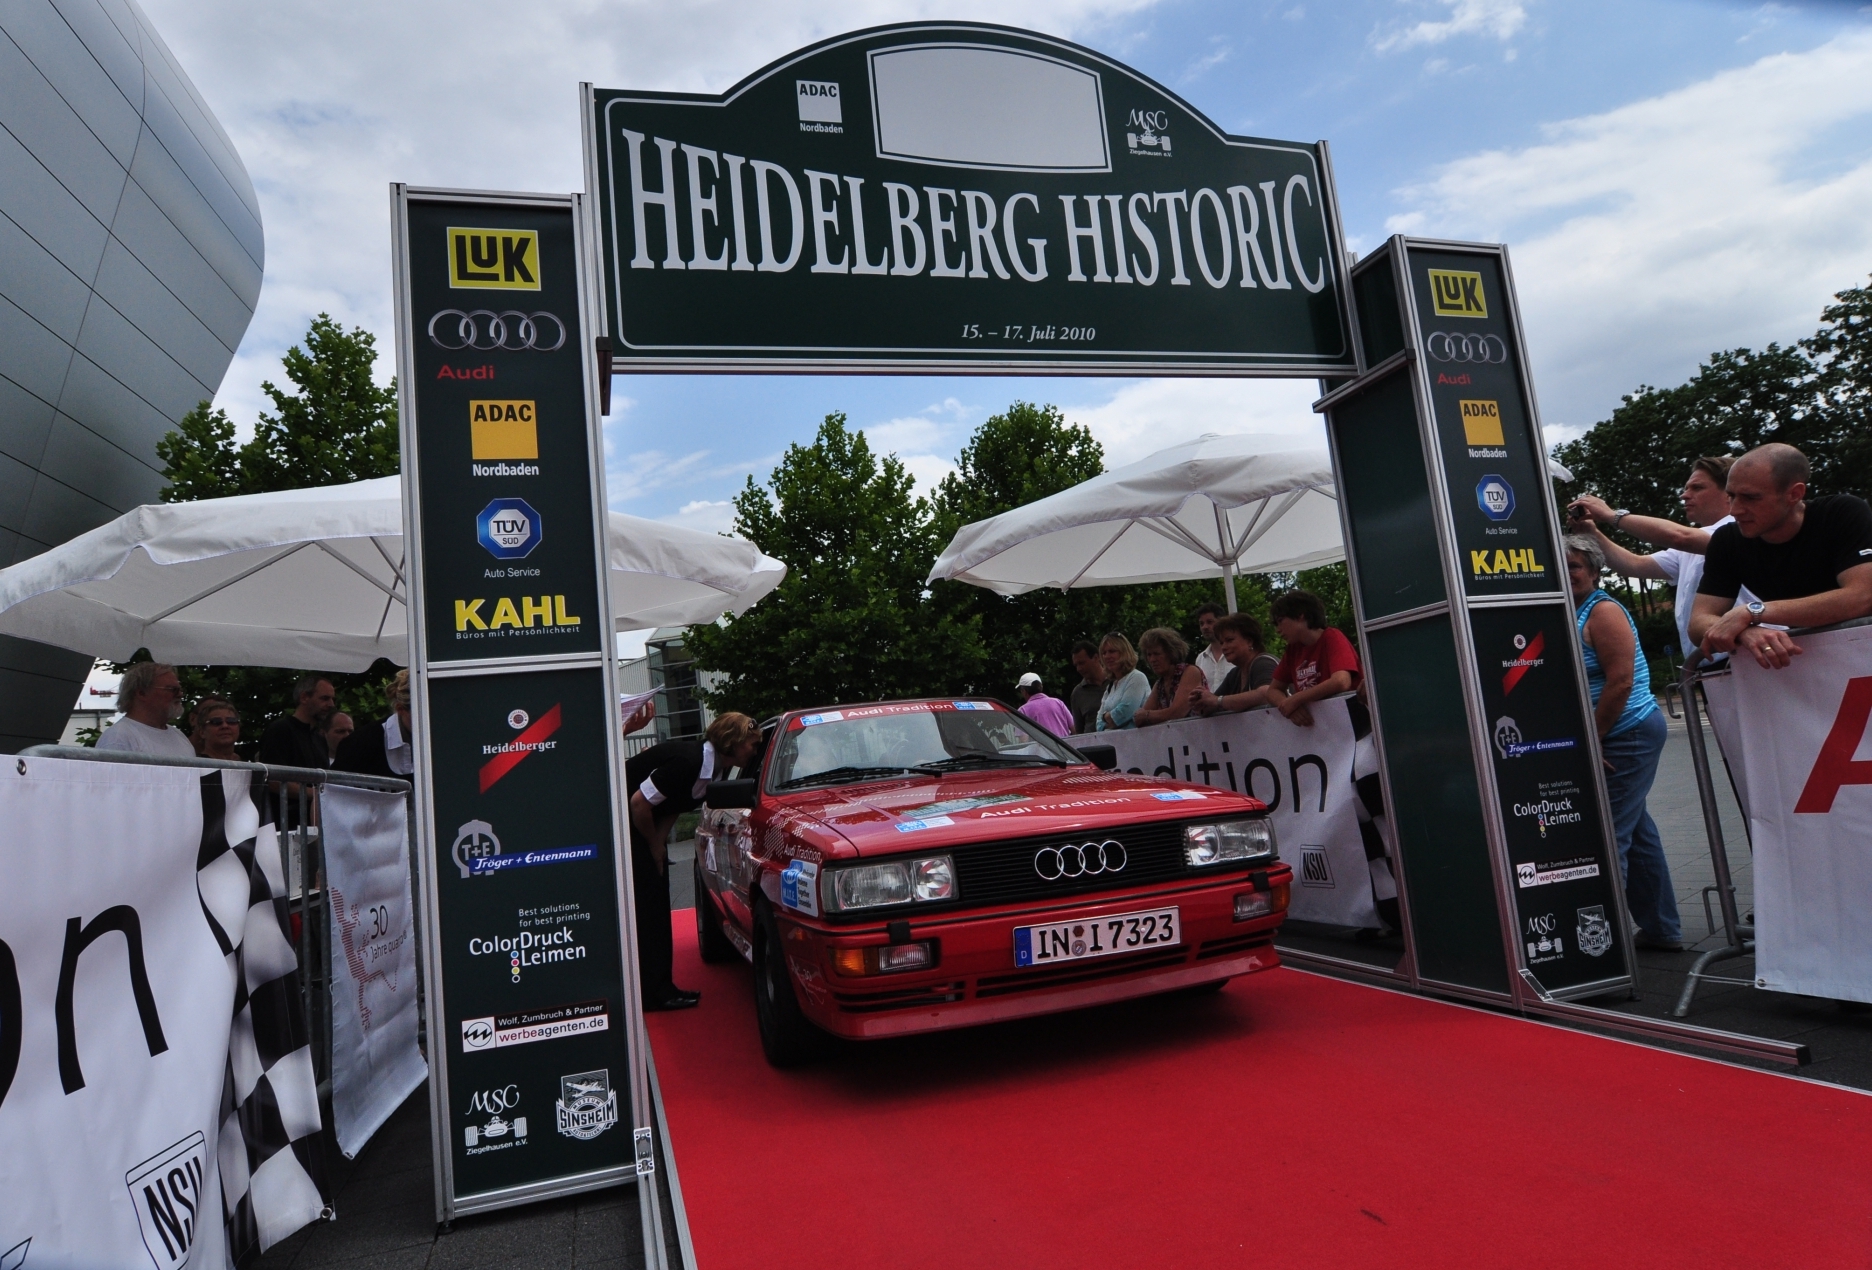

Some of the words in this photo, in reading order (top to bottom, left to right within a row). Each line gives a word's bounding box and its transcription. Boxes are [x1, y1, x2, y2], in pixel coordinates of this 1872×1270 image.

[800, 84, 838, 98] ADAC
[1126, 108, 1168, 131] MSC
[800, 122, 843, 134] Nordbaden
[1129, 148, 1162, 158] Ziegelhausen
[622, 128, 1048, 282] HEIDELBERG
[1058, 174, 1325, 293] HISTORIC
[961, 324, 983, 339] 15.
[1004, 325, 1024, 340] 17.
[1026, 325, 1056, 343] Juli
[1059, 327, 1096, 341] 2010
[437, 365, 495, 380] Audi
[1438, 373, 1472, 384] Audi
[474, 404, 532, 422] ADAC
[1464, 403, 1496, 417] ADAC
[1468, 448, 1507, 458] Nordbaden
[472, 463, 539, 476] Nordbaden
[1486, 491, 1505, 502] TÜV
[492, 519, 526, 534] TÜV
[502, 537, 519, 545] SÜD
[1471, 548, 1544, 574] KAHL
[484, 568, 505, 578] Auto
[508, 568, 540, 577] Service
[454, 595, 580, 631] KAHL
[456, 632, 484, 640] Büros
[488, 630, 504, 638] mit
[509, 626, 580, 636] Persönlichkeit
[1502, 658, 1544, 668] Heidelberger
[848, 708, 883, 717] Audi
[888, 703, 952, 713] Tradition
[482, 741, 557, 754] Heidelberger
[1536, 740, 1574, 750] Entenmann
[1538, 782, 1549, 790] Best
[1550, 780, 1572, 788] solutions
[1560, 787, 1580, 796] printing
[980, 806, 1032, 818] Audi
[1035, 796, 1131, 811] Tradition
[1514, 798, 1572, 816] ColorDruck
[1544, 811, 1581, 826] Leimen
[475, 858, 513, 870] Tröger
[525, 849, 592, 864] Entenmann
[784, 844, 796, 856] Audi
[796, 846, 821, 861] Tradition
[1302, 852, 1328, 881] NSU
[1539, 866, 1596, 881] werbeagenten.de
[518, 907, 538, 916] Best
[540, 903, 580, 914] solutions
[370, 905, 388, 940] 30
[519, 919, 532, 928] for
[534, 916, 553, 926] best
[556, 911, 590, 924] printing
[1526, 913, 1556, 934] MSC
[469, 926, 574, 956] ColorDruck
[1038, 928, 1070, 959] IN
[370, 944, 387, 963] Jahre
[521, 945, 586, 967] Leimen
[1020, 950, 1028, 959] D
[1530, 955, 1556, 964] Ziegelhausen
[498, 1017, 520, 1027] Wolf,
[522, 1009, 564, 1023] Zumbruch
[566, 1008, 572, 1016] &
[574, 1004, 603, 1014] Partner
[499, 1018, 604, 1043] werbeagenten.de
[465, 1084, 520, 1115] MSC
[572, 1098, 600, 1110] MUSEUM
[560, 1098, 614, 1128] SINSHEIM
[466, 1141, 513, 1155] Ziegelhausen
[516, 1138, 528, 1146] e.V.
